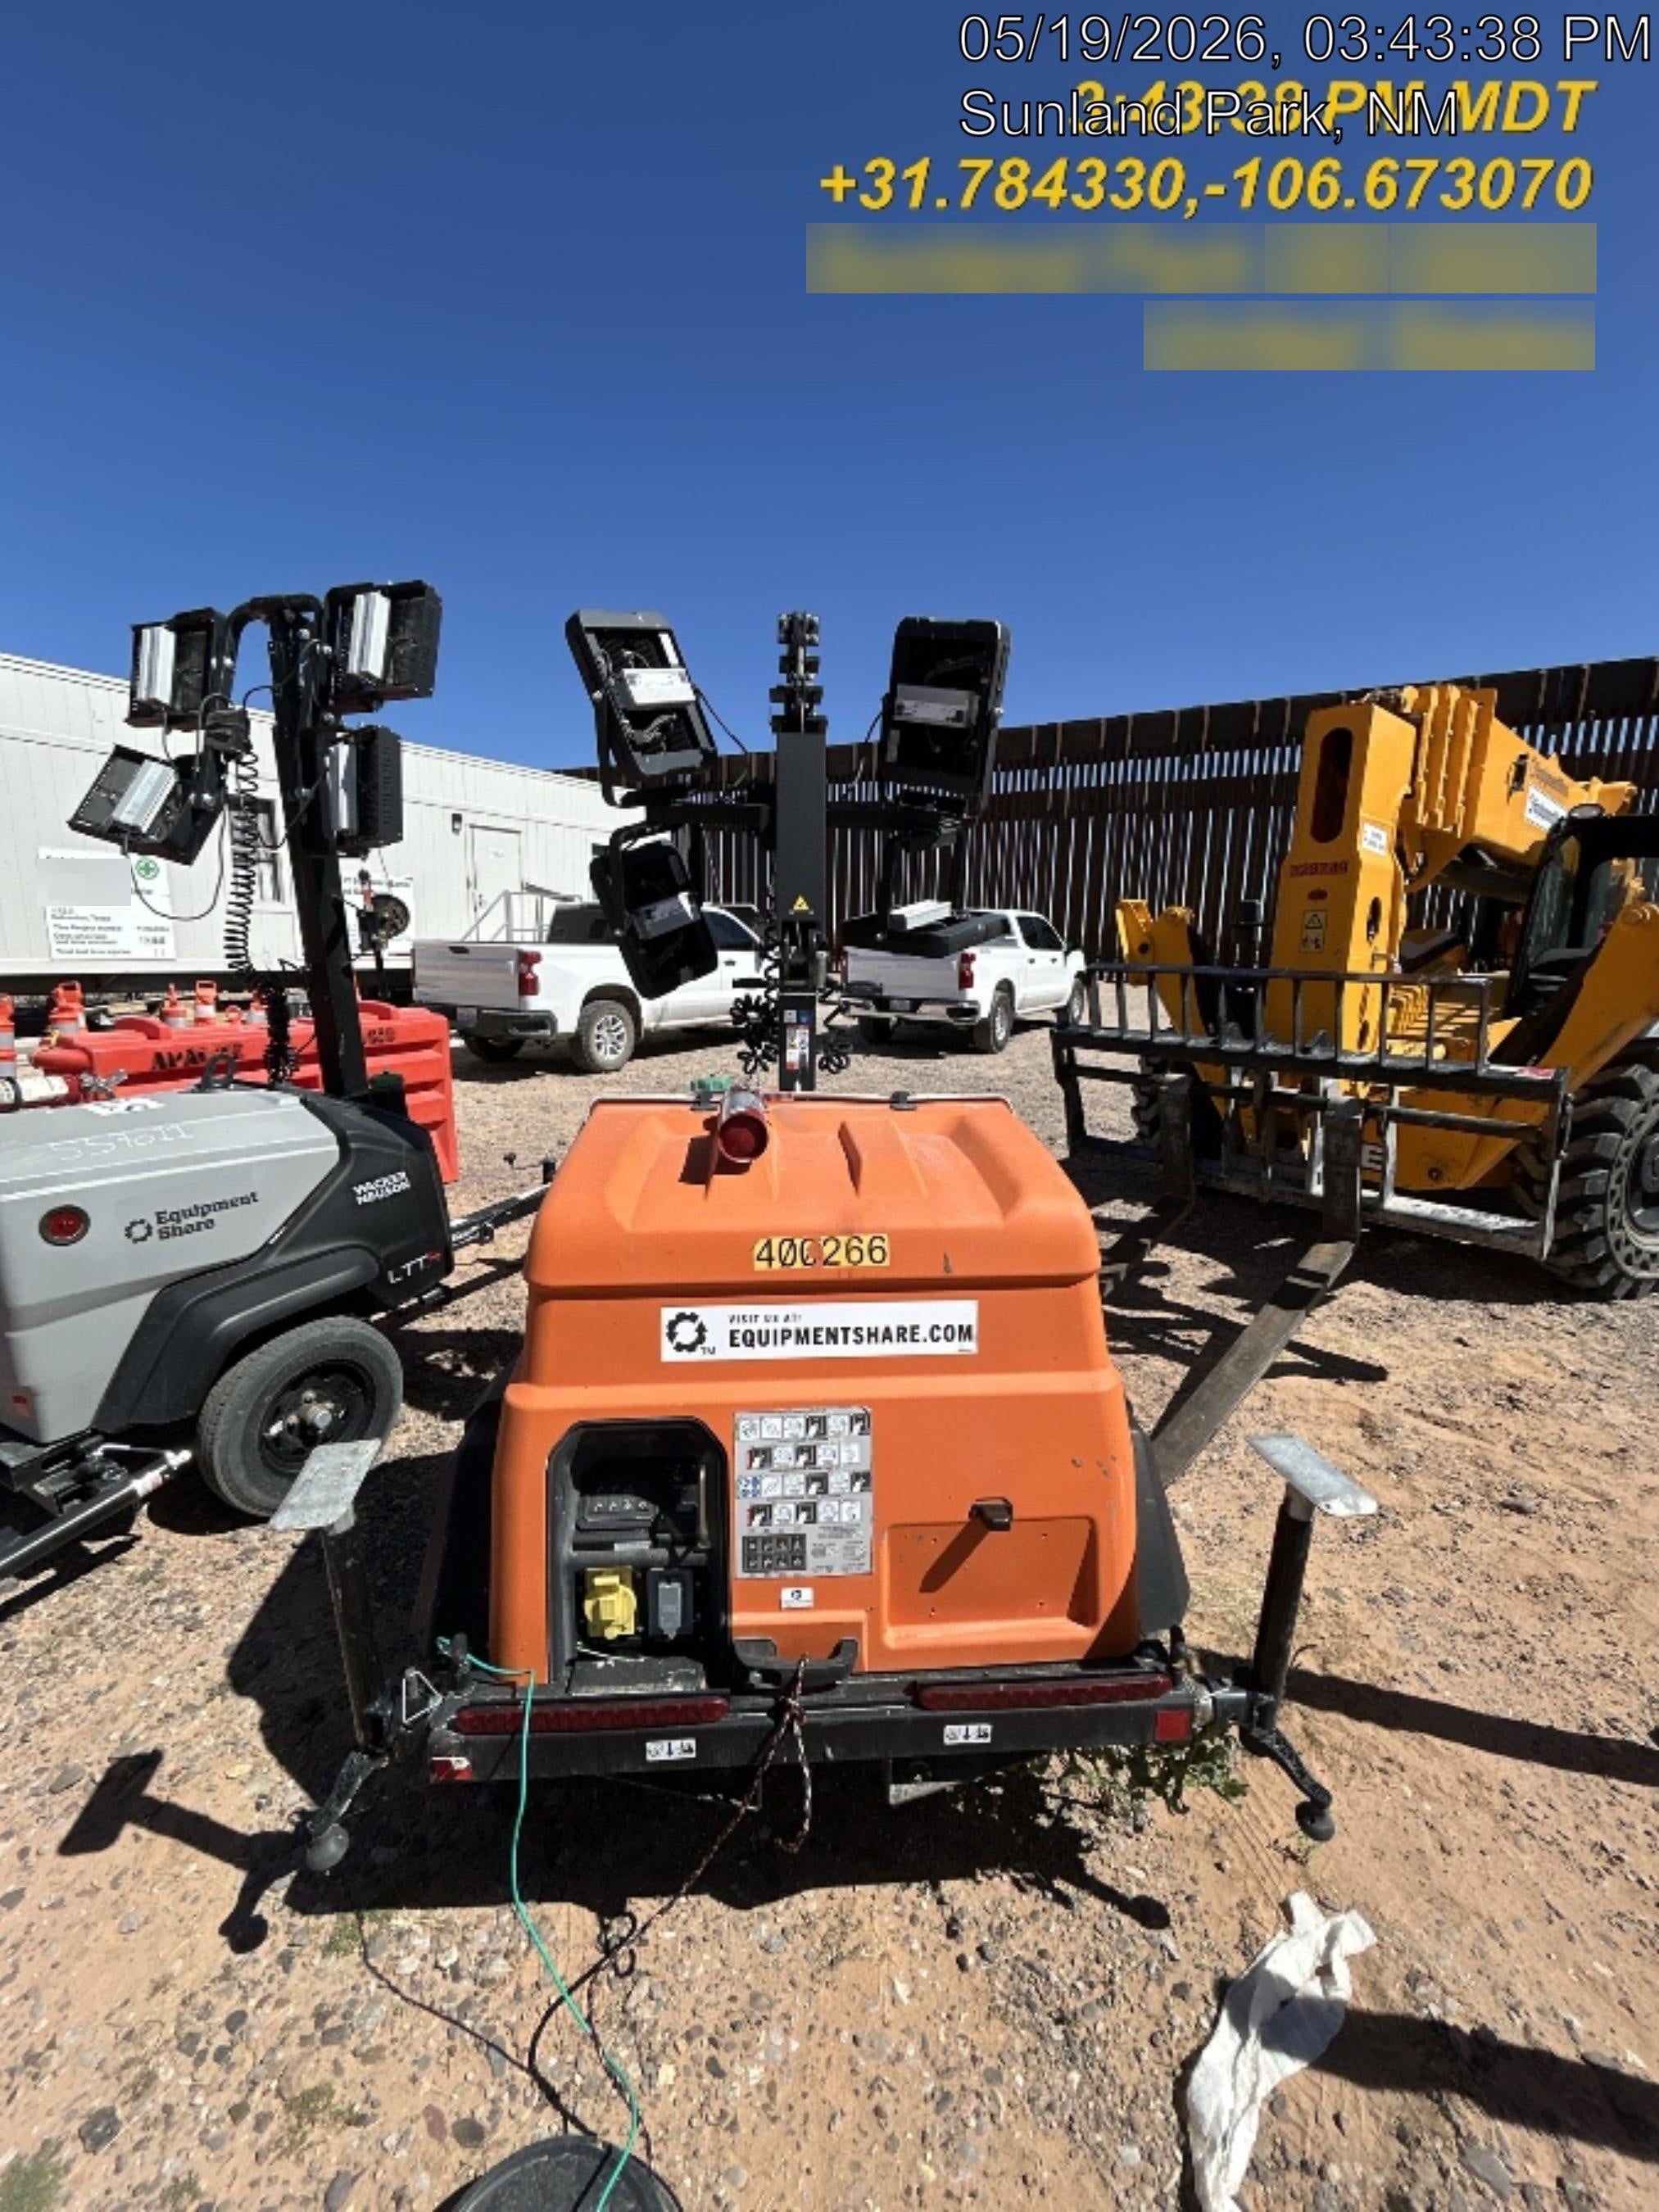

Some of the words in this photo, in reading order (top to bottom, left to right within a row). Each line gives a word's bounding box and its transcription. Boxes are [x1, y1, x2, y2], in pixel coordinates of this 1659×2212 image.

[154, 1191, 259, 1226] Equipment
[157, 1217, 215, 1241] Share
[728, 1313, 759, 1324] VISIT
[728, 1323, 973, 1349] EQUIPMENTSHARE.COM
